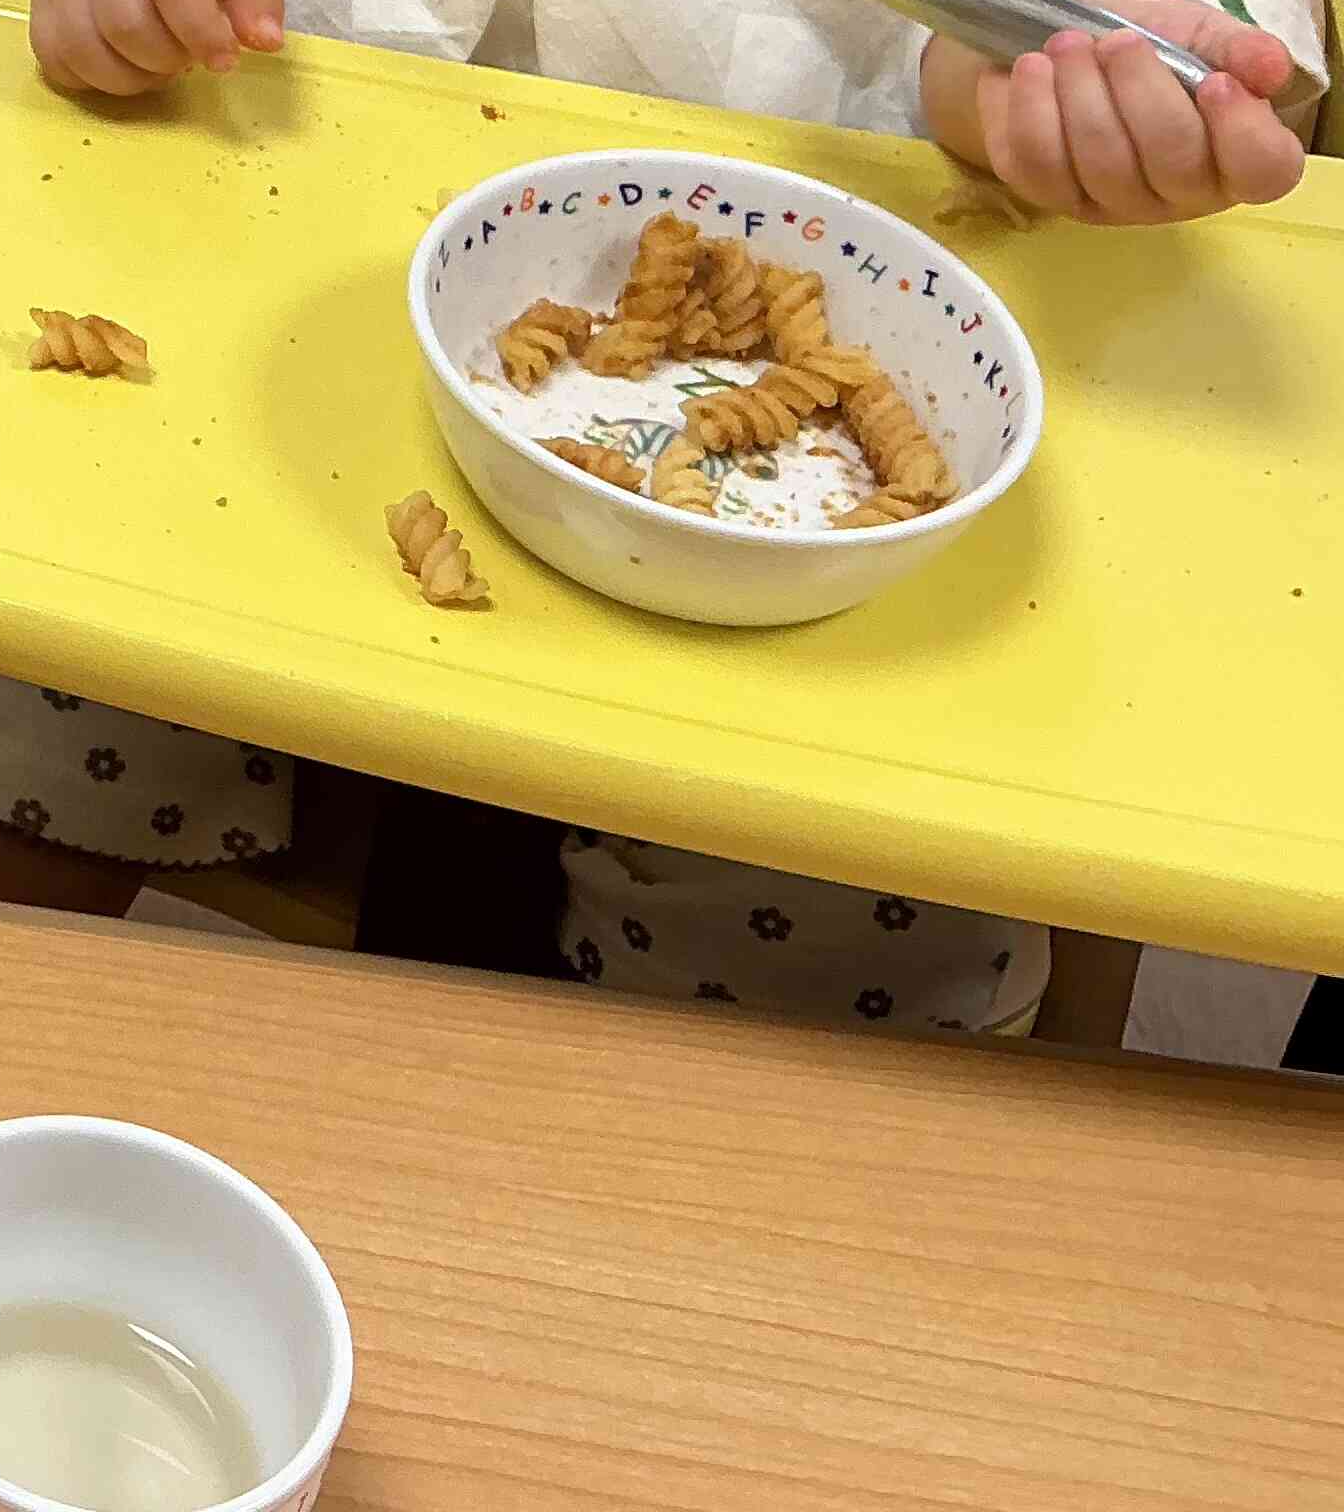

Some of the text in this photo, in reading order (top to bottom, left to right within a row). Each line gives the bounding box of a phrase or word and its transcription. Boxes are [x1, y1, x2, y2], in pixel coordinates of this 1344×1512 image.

[482, 220, 497, 245] A
[520, 187, 535, 212] B
[561, 191, 582, 215] C
[618, 183, 643, 206] D
[686, 184, 716, 210] E
[745, 211, 766, 238] F
[800, 216, 825, 242] G
[857, 253, 888, 284] H
[922, 269, 939, 297] I
[960, 312, 983, 334] J
[984, 359, 1004, 391] K
